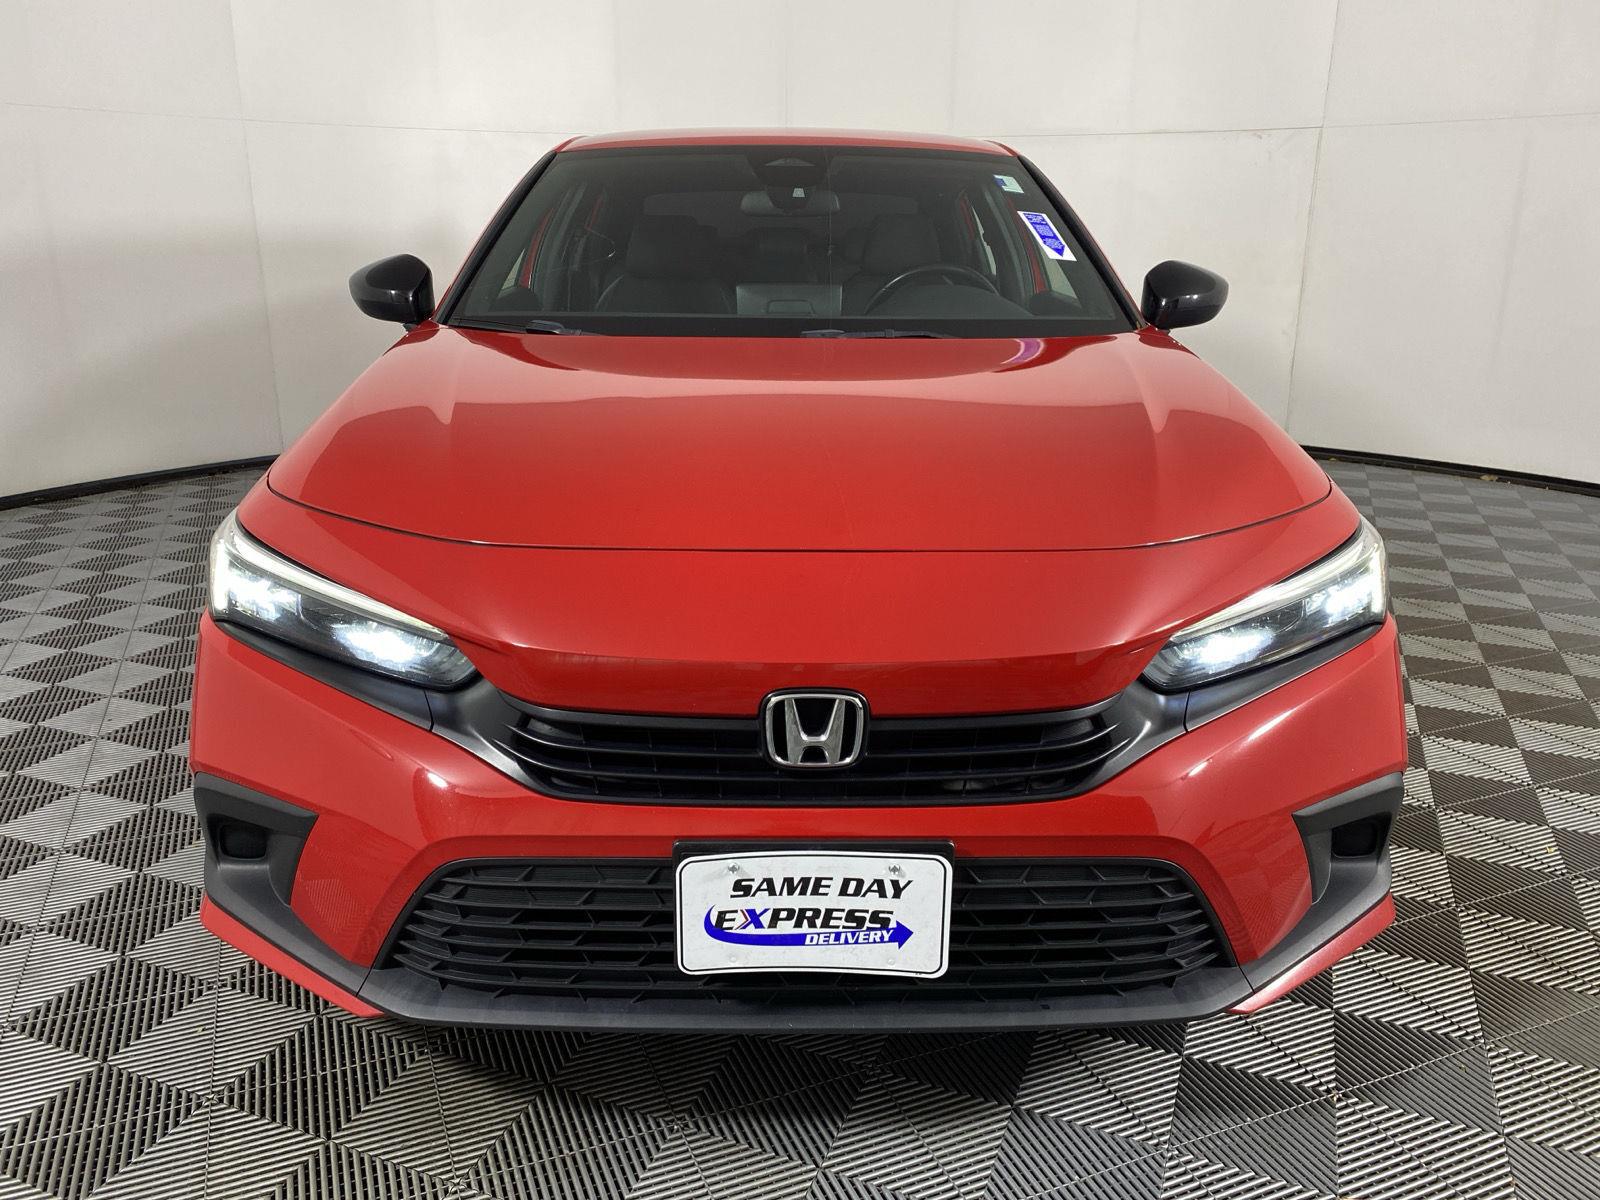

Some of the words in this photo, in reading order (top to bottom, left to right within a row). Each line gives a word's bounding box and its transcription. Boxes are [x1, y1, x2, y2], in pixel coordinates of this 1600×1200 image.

[730, 877, 834, 899] SAME
[838, 877, 914, 900] DAY
[714, 907, 895, 931] EXPRESS
[804, 930, 895, 946] DELIVERY
